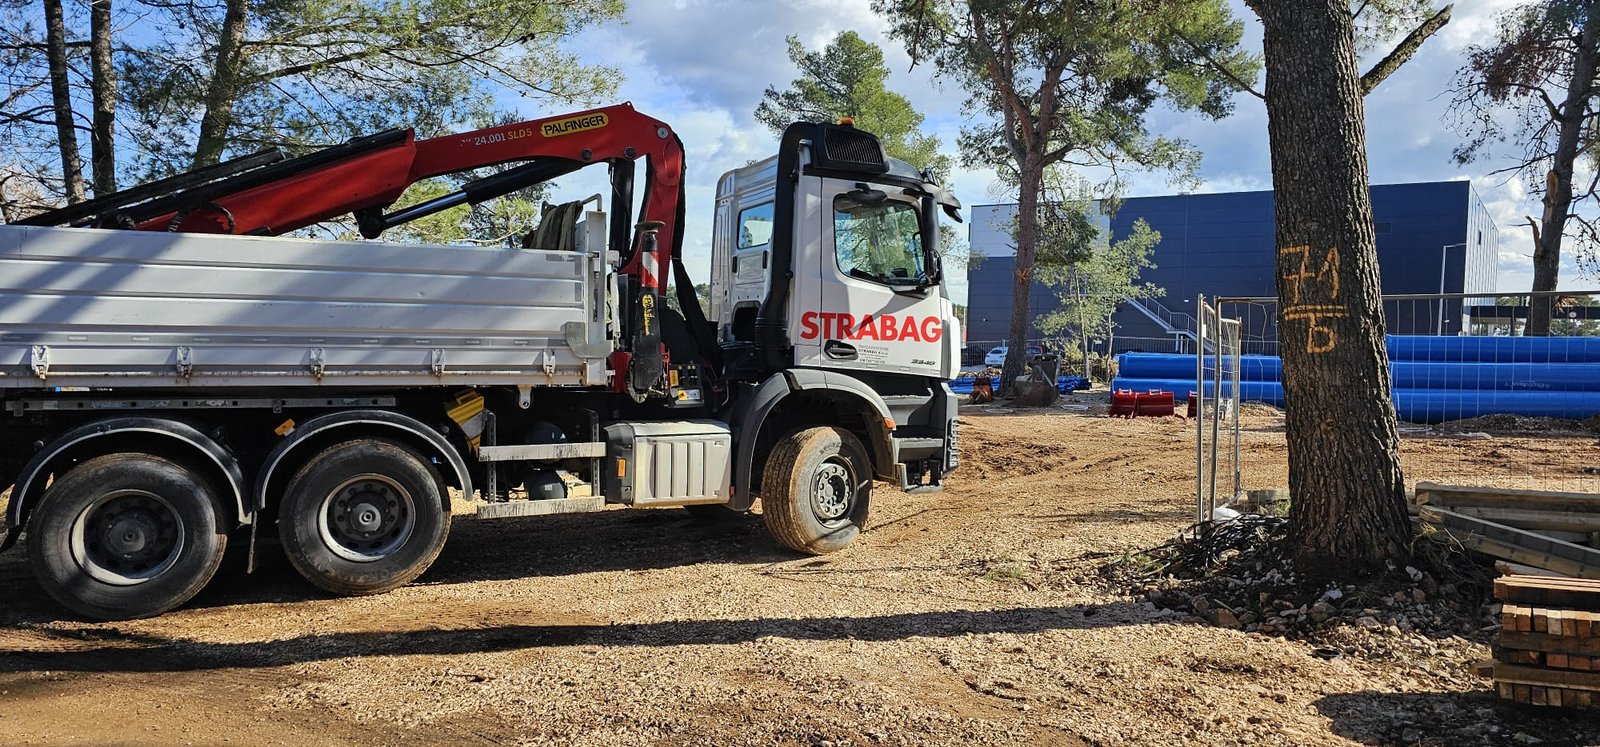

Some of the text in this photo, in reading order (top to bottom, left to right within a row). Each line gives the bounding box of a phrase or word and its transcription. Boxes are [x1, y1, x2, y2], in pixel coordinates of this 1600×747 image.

[543, 115, 605, 135] PALFINGER
[474, 133, 506, 146] 24.001
[800, 311, 942, 343] STRABAG
